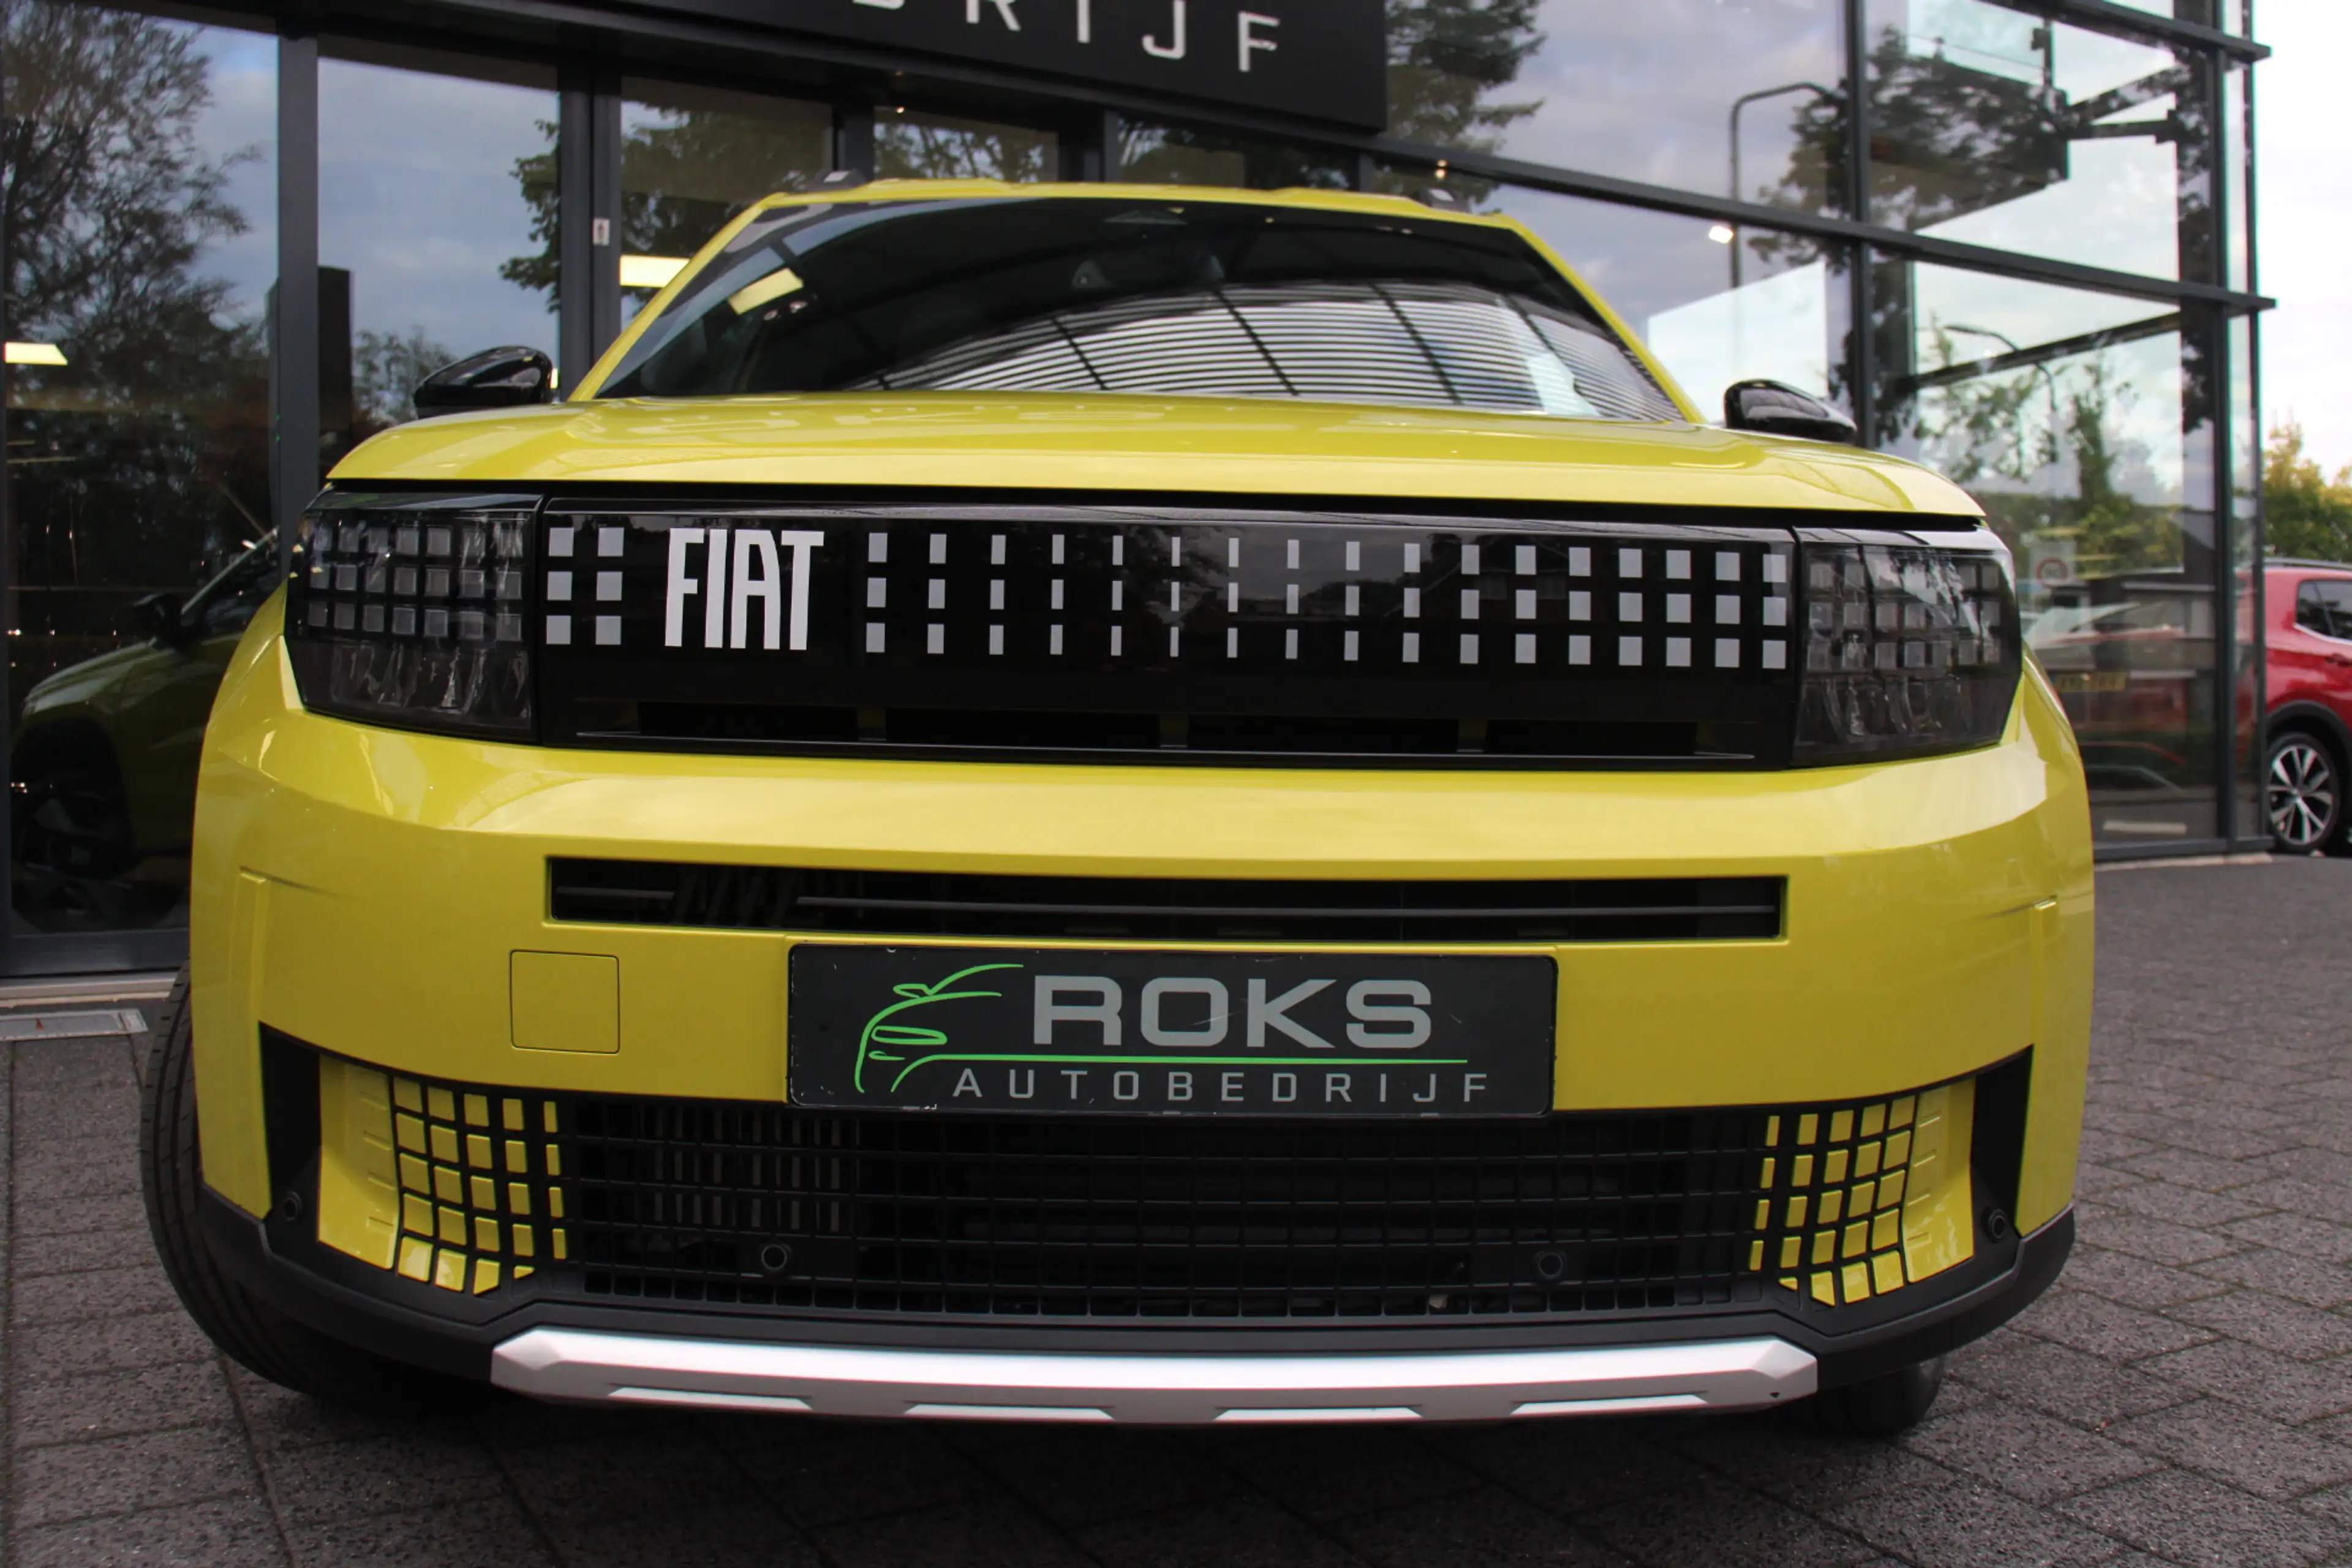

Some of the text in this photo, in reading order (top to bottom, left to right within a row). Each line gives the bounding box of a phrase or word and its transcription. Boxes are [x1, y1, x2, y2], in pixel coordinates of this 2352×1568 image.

[854, 0, 1280, 72] IJF
[665, 527, 824, 650] FIAT
[1033, 975, 1432, 1049] ROKS
[952, 1068, 1487, 1102] AUTOBEDRIJF
